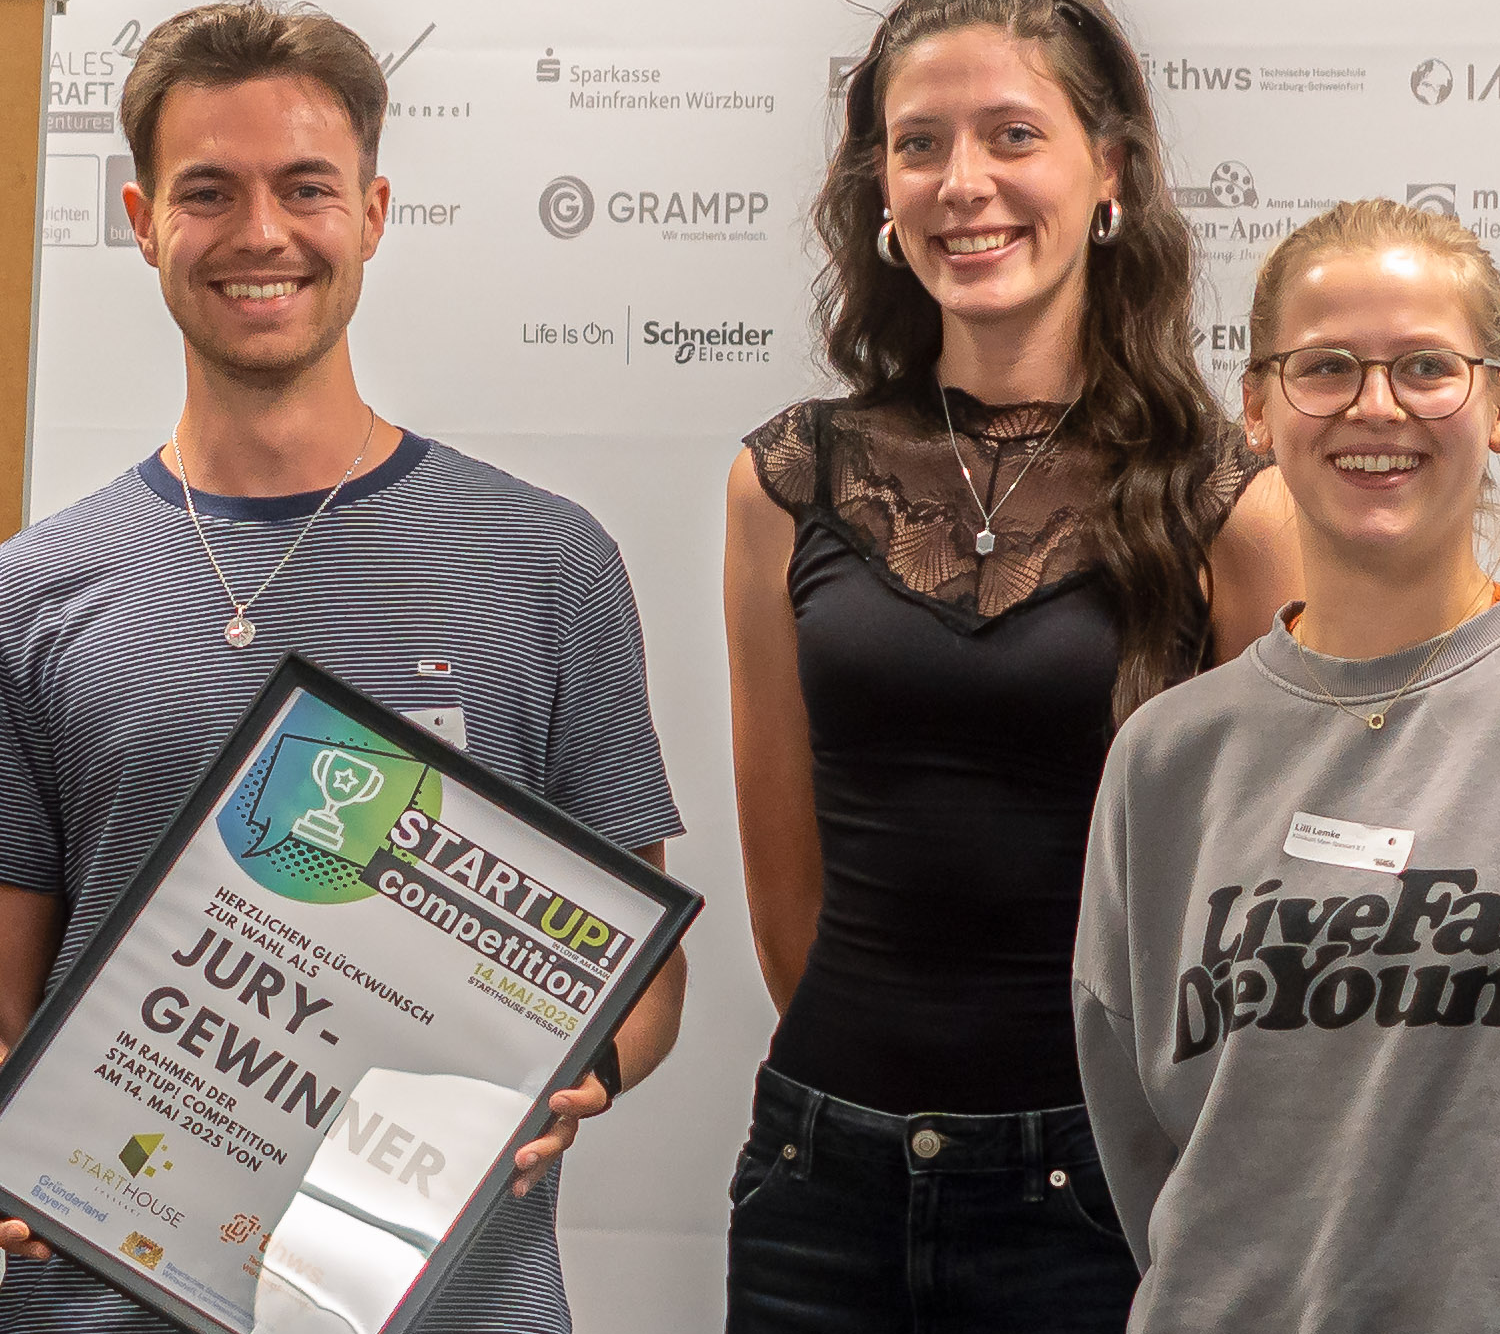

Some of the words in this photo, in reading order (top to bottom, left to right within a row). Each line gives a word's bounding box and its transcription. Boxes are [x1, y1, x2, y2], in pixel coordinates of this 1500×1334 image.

[569, 64, 661, 88] Sparkasse
[569, 90, 680, 109] Mainfranken
[686, 90, 775, 113] Würzburg
[1163, 58, 1252, 91] thws
[385, 197, 461, 226] imer
[607, 191, 770, 225] GRAMPP
[1266, 197, 1294, 209] Anne
[1471, 216, 1500, 240] die
[522, 323, 558, 345] Life
[562, 323, 578, 345] Is
[643, 320, 774, 347] Schneider
[698, 347, 770, 363] Electric
[390, 809, 627, 968] STARTUP!
[203, 901, 239, 931] ZUR
[240, 922, 284, 960] WAHL
[286, 953, 320, 979] ALS
[214, 886, 312, 951] HERZLICHEN
[312, 945, 435, 1026] GLÜCKWUNSCH
[378, 868, 596, 1013] competition
[171, 927, 340, 1046] JURY-
[467, 975, 527, 1015] STARTHOUSE
[525, 1009, 572, 1041] SPESSART
[472, 962, 495, 985] 14.
[497, 979, 534, 1005] MAI
[531, 997, 580, 1032] 2025
[115, 1030, 138, 1051] IM
[137, 1043, 207, 1092] RAHMEN
[205, 1085, 238, 1113] DER
[140, 985, 447, 1200] GEWINNER
[93, 1063, 124, 1087] AM
[123, 1080, 142, 1102] 14.
[146, 1094, 180, 1122] MAI
[179, 1115, 225, 1148] 2025
[226, 1140, 264, 1173] VON
[104, 1047, 182, 1100] STARTUP!
[182, 1094, 289, 1166] COMPETITION
[30, 1184, 71, 1216] Bayern
[38, 1174, 110, 1223] Gründerland
[68, 1148, 186, 1229] STARTHOUSE
